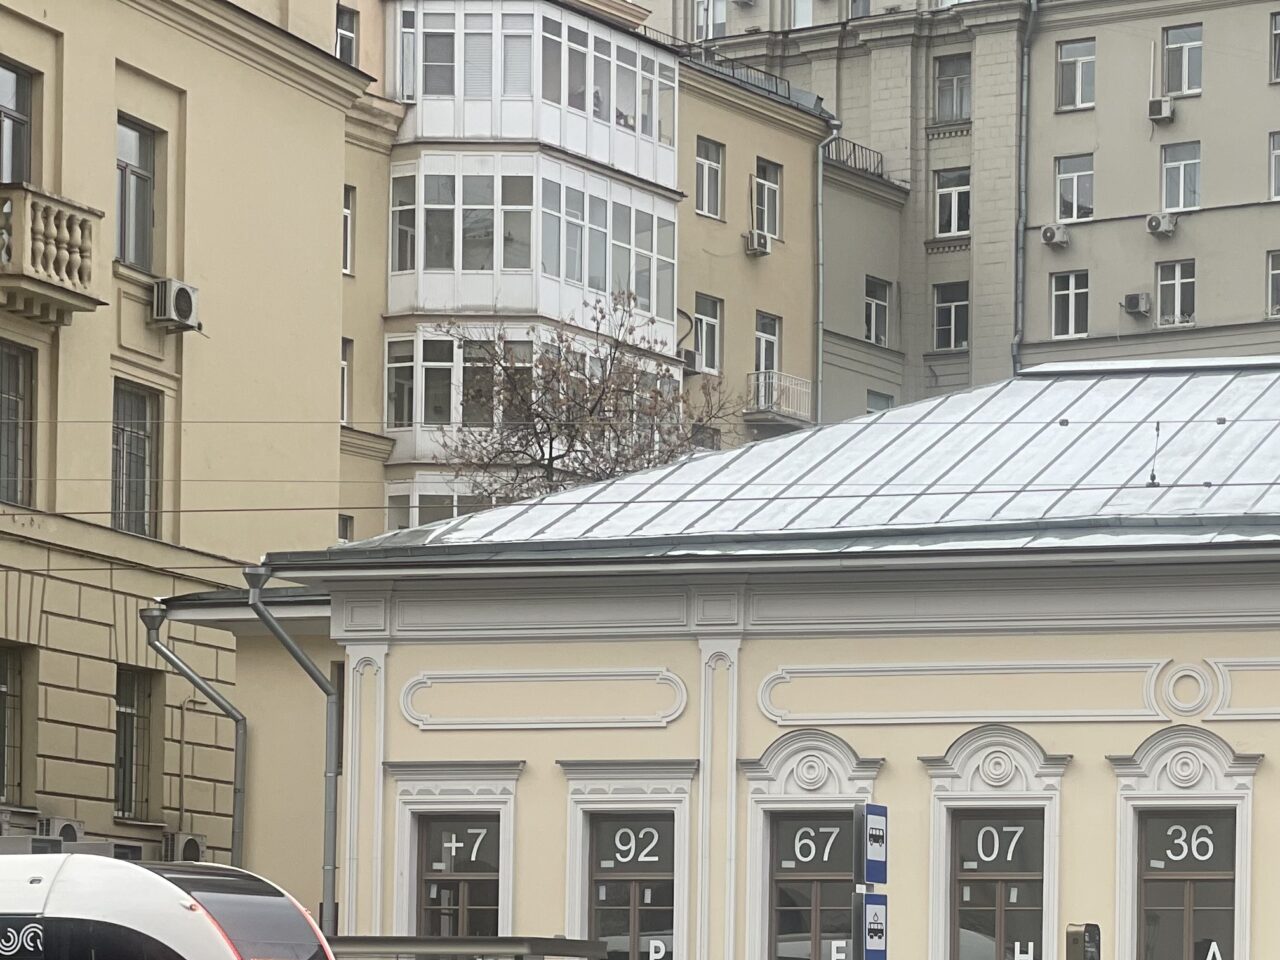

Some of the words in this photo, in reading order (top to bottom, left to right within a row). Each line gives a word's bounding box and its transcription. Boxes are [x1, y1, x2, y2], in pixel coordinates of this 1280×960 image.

[443, 829, 487, 861] +7
[614, 827, 659, 863] 92
[794, 827, 840, 862] 67
[977, 826, 1024, 862] 07
[1165, 824, 1214, 861] 36
